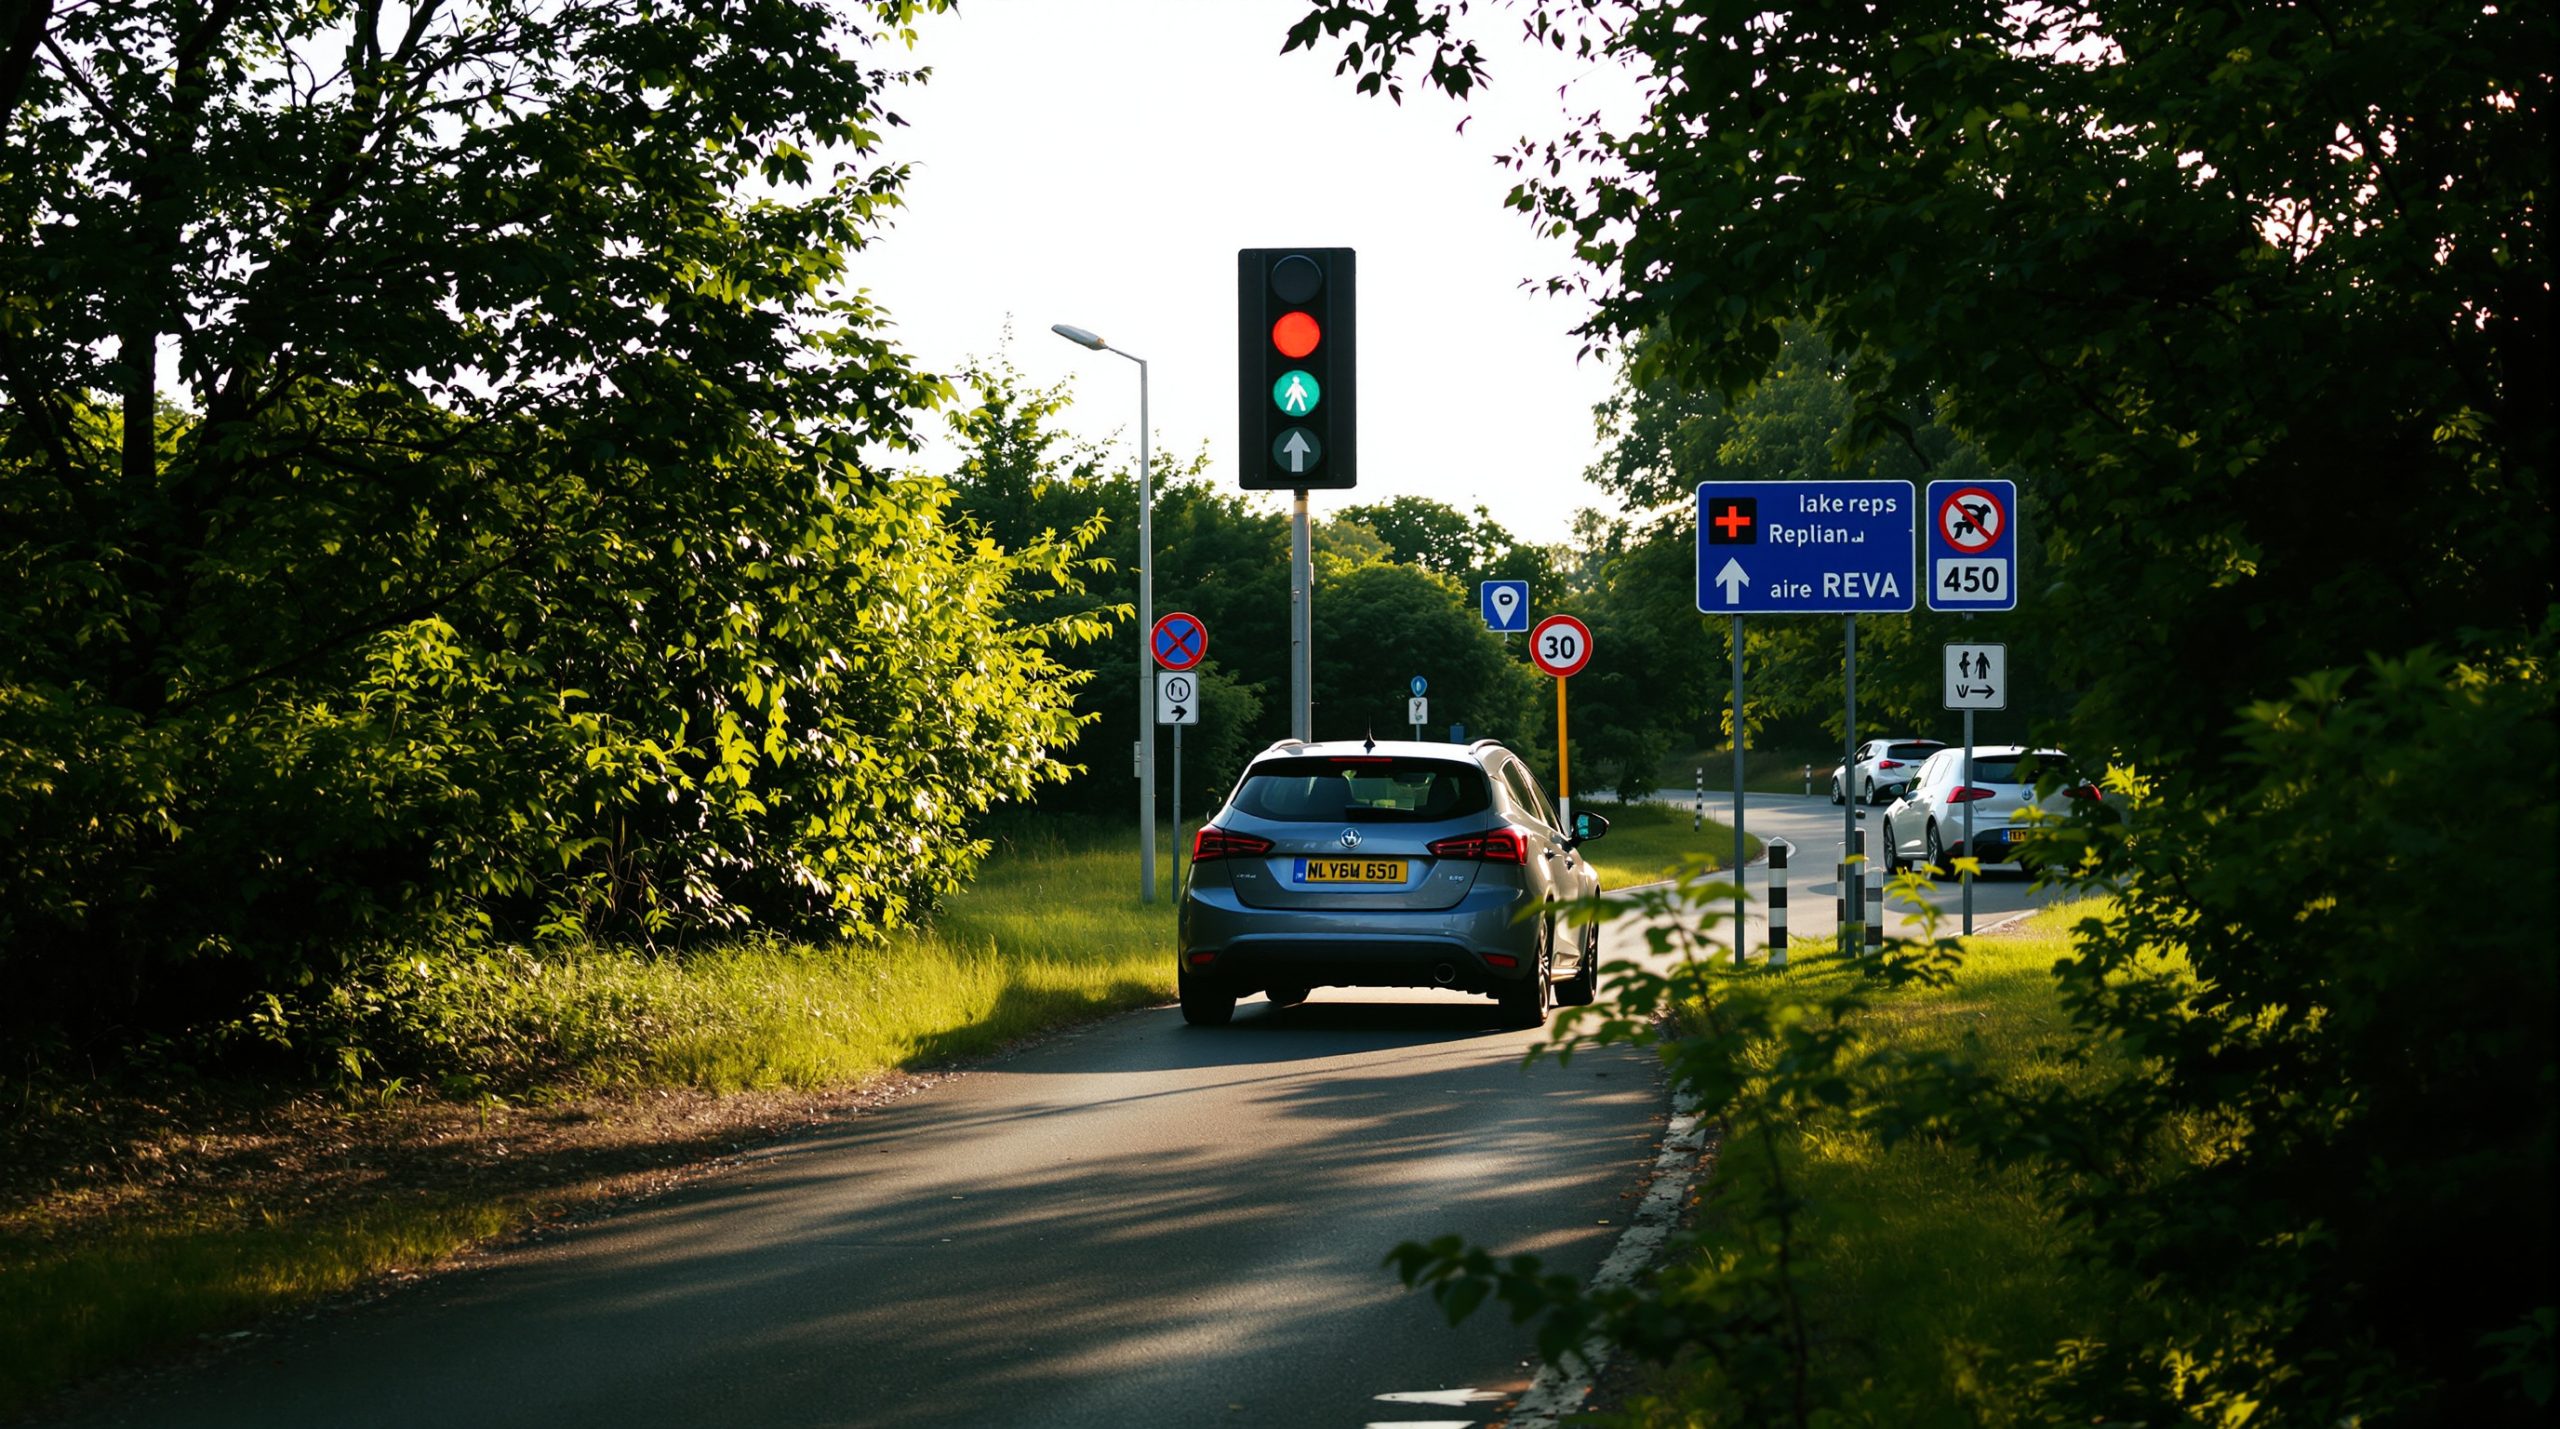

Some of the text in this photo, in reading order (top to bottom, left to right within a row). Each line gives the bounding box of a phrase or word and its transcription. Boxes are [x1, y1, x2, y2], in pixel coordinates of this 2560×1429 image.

[1849, 498, 1897, 517] reps
[1770, 572, 1900, 598] aire REVA
[1943, 566, 2000, 593] 450
[1545, 636, 1576, 660] 30
